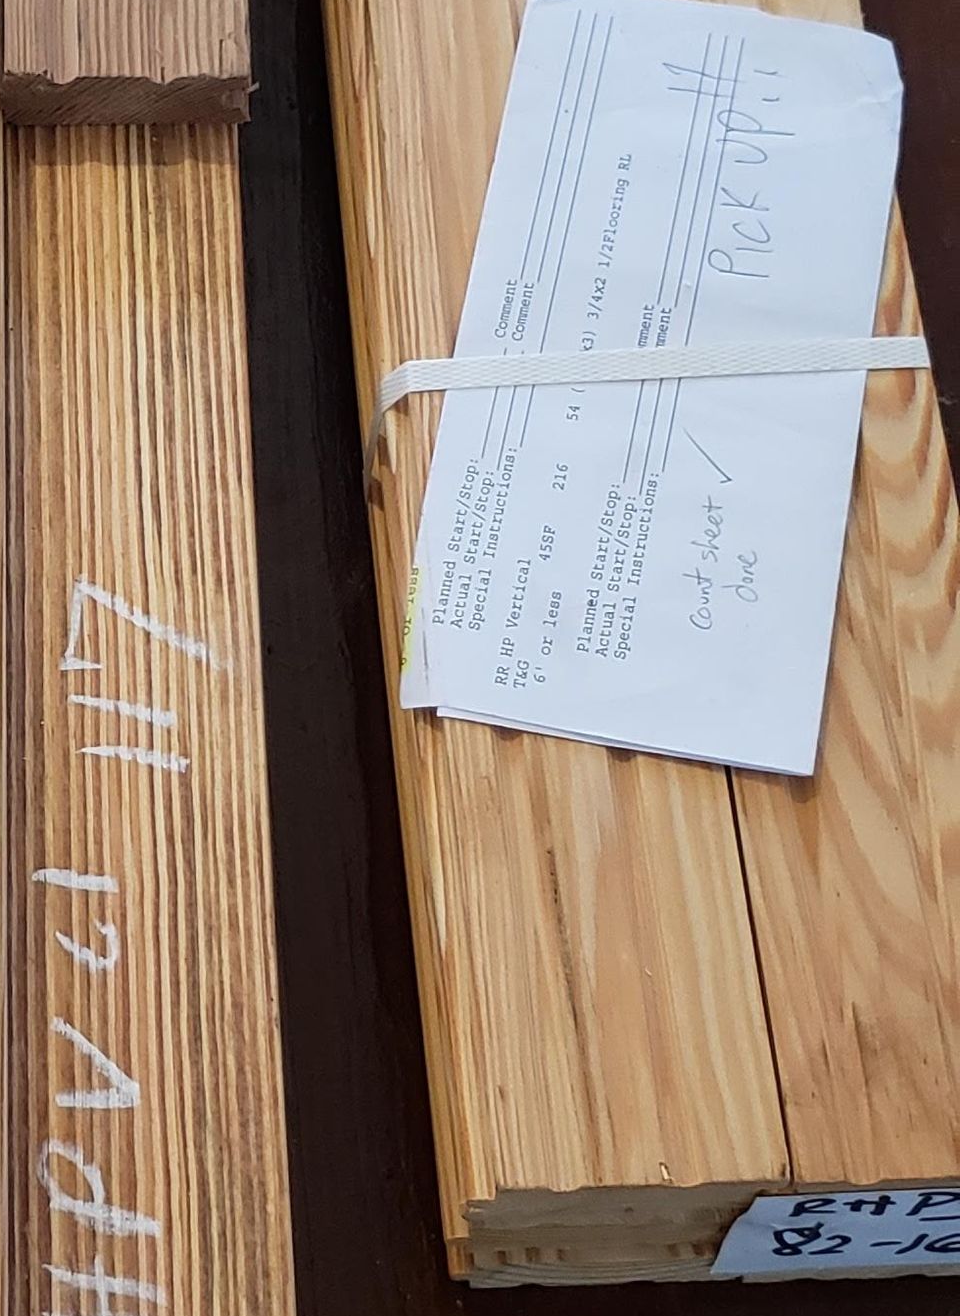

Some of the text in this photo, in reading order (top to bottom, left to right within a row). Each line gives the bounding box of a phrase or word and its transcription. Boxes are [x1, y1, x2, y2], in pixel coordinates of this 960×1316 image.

[618, 154, 632, 171] RL
[598, 179, 630, 268] 1/2Flooring
[494, 279, 518, 339] Comment
[512, 282, 535, 342] Comment
[588, 277, 607, 320] 3/4x2
[567, 405, 581, 421] 54
[553, 463, 570, 491] 216
[433, 458, 480, 625] Planned Start/Stop:
[450, 470, 494, 629] Actual Start/Stop:
[468, 447, 518, 631] Special Instructions:
[539, 524, 557, 561] 45SF
[577, 484, 621, 653] Planned Start/Stop:
[614, 473, 659, 660] Special Instructions:
[595, 495, 637, 658] Actual Start/Stop:
[495, 559, 532, 686] RR HP Vertical
[543, 590, 562, 628] less
[514, 660, 530, 689] T&G
[541, 636, 554, 656] or
